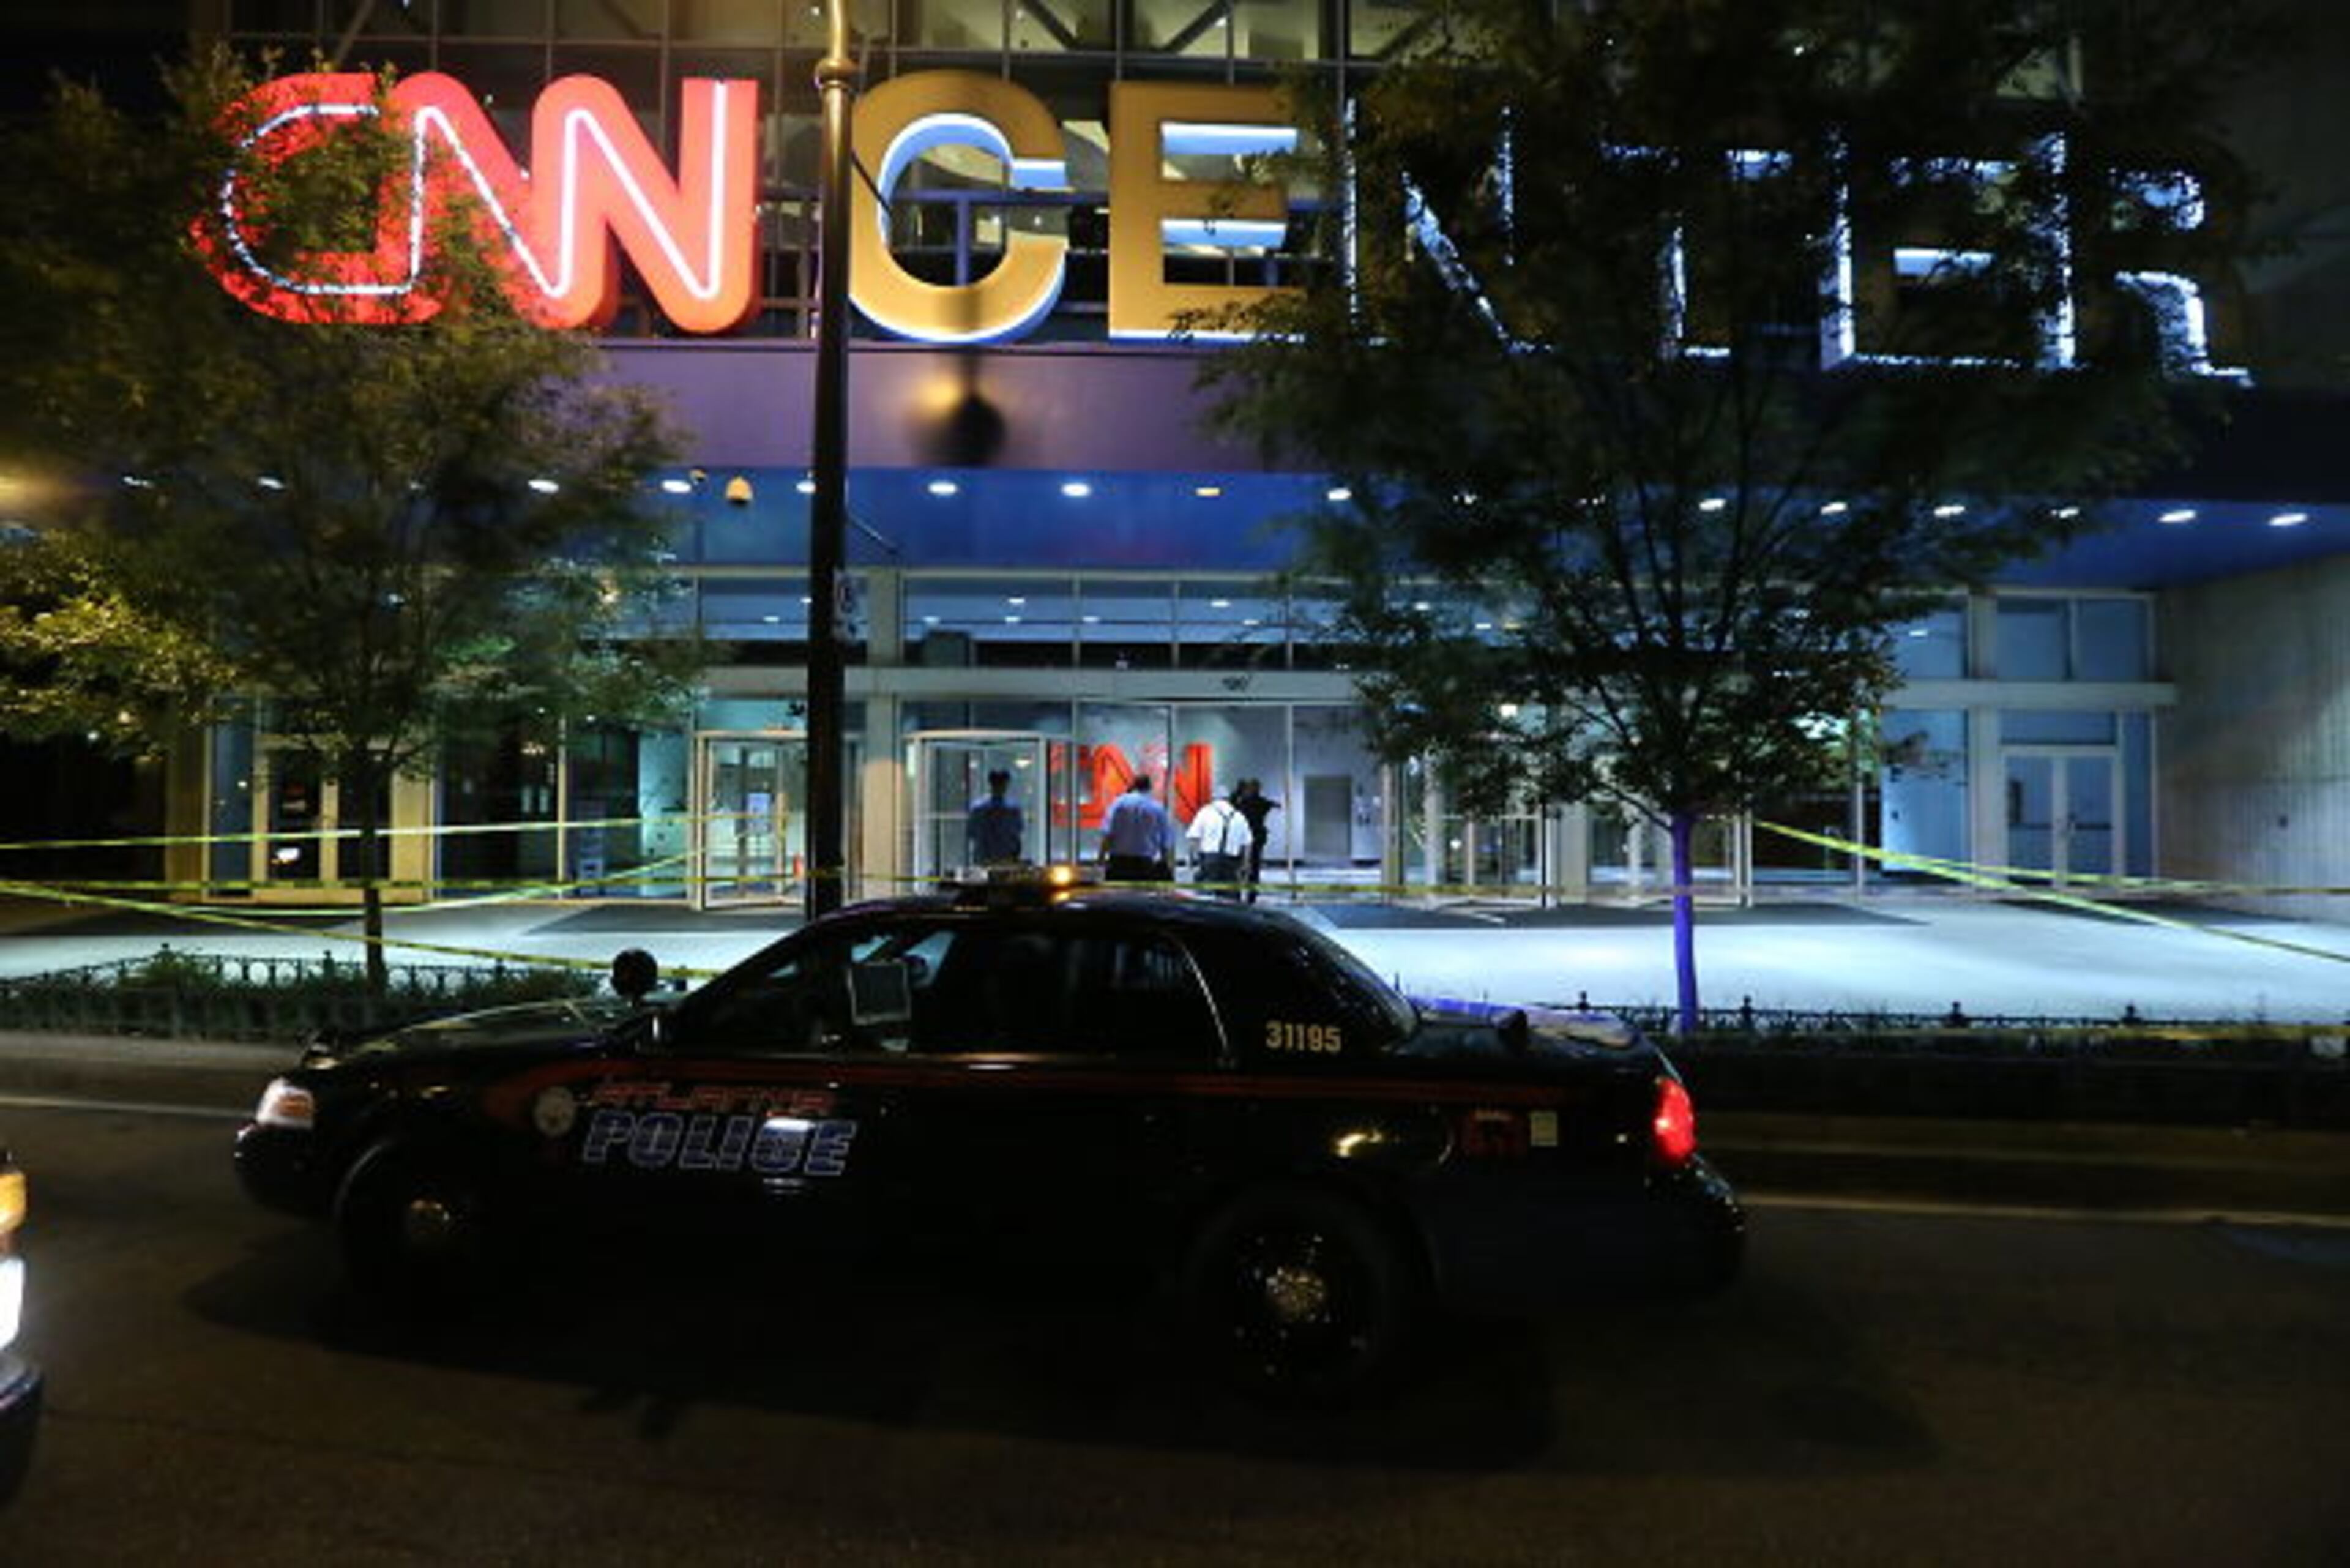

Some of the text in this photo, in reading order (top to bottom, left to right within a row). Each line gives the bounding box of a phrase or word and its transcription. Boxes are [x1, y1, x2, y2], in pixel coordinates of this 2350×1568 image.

[188, 71, 759, 334] CNN
[1266, 1020, 1342, 1053] 31195
[583, 1109, 857, 1176] POLICE
